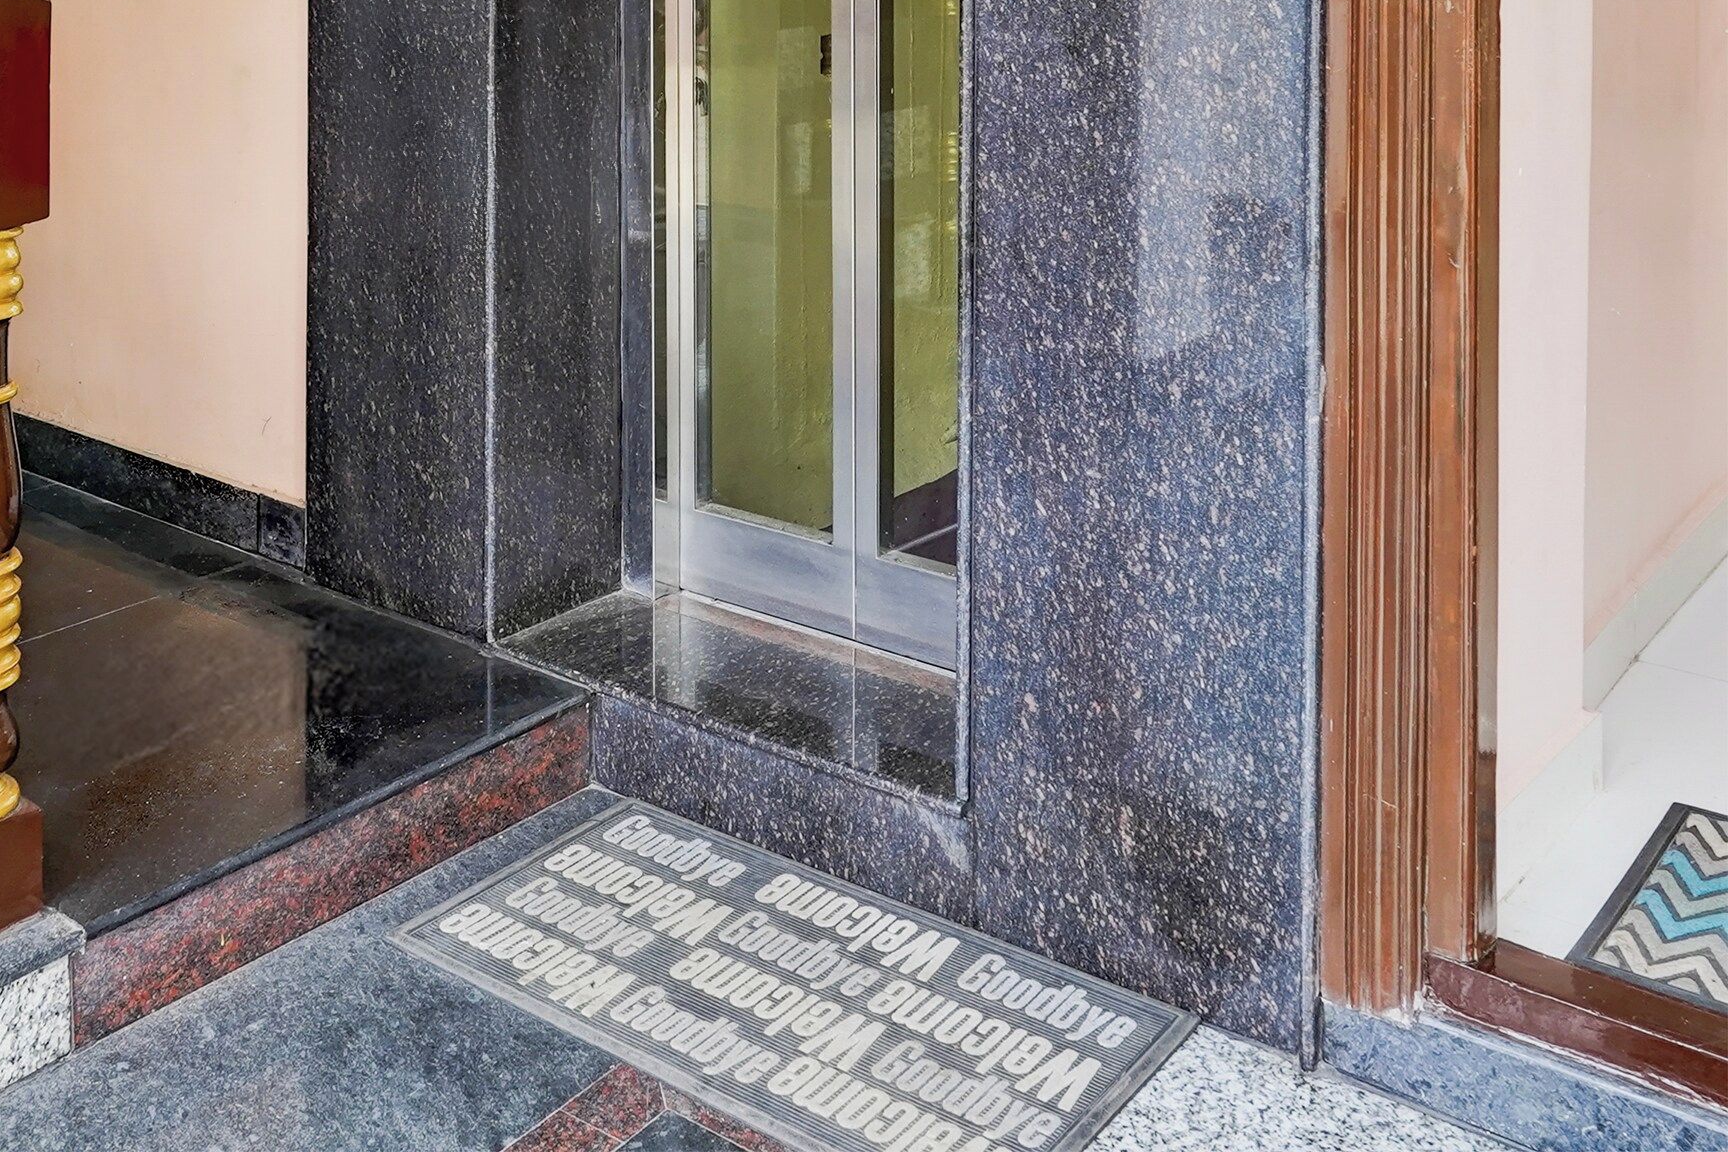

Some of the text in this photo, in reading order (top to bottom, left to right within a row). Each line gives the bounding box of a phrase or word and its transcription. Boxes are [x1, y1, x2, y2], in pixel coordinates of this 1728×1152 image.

[439, 903, 636, 1018] Welcome
[609, 985, 780, 1084] Goodbye
[505, 876, 1063, 1148] Goodbye Welcome Goodbye
[544, 844, 1101, 1113] Welcome Goodbye Welcome
[603, 815, 1138, 1048] Goodbye Welcome Goodbye
